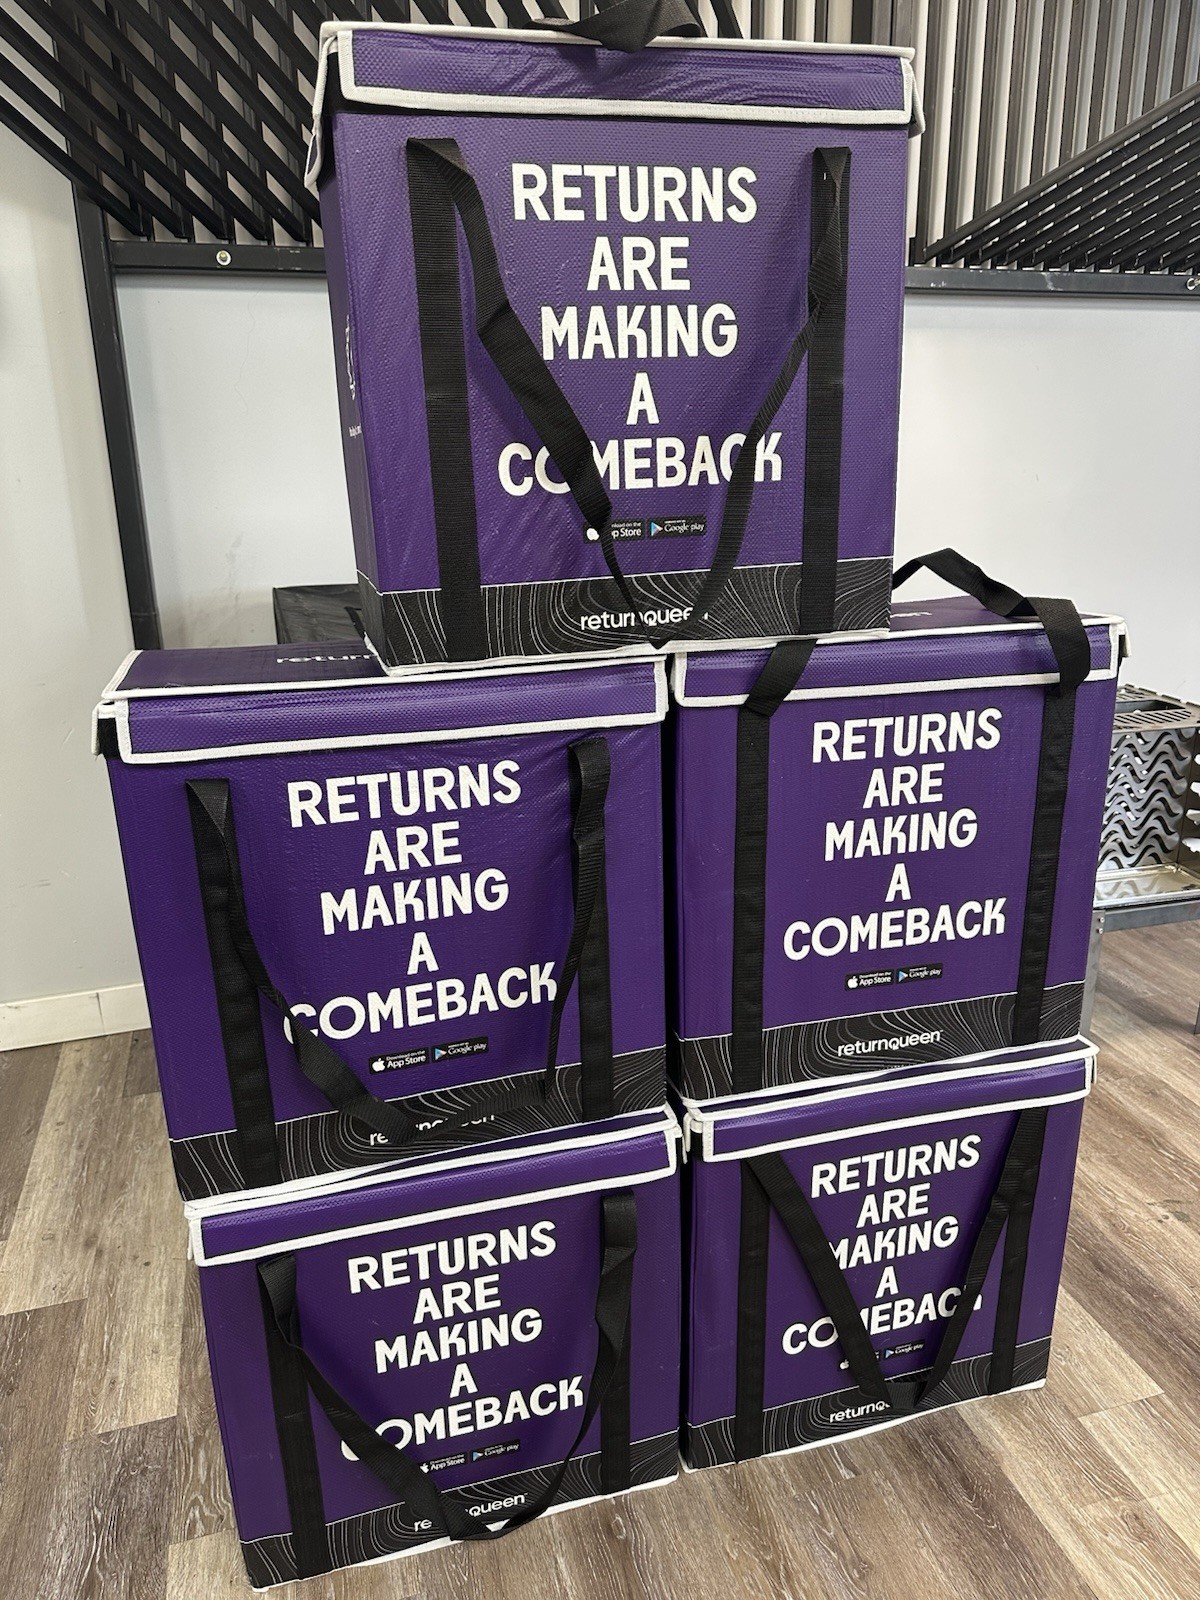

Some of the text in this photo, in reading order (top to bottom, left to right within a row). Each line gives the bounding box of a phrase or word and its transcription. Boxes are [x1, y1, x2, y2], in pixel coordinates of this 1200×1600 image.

[512, 163, 757, 223] RETURNS
[587, 237, 690, 293] ARE
[541, 304, 737, 361] MAKING
[627, 372, 659, 425] A
[620, 527, 642, 537] Store
[664, 522, 704, 533] Google play
[813, 708, 1002, 763] RETURNS
[288, 760, 520, 828] RETURNS
[863, 763, 944, 808] ARE
[364, 821, 462, 875] ARE
[825, 809, 977, 861] MAKING
[321, 869, 508, 936] MAKING
[885, 863, 911, 903] A
[408, 932, 438, 974] A
[784, 898, 1006, 961] COMEBACK
[859, 976, 892, 986] App Store
[909, 970, 928, 978] Google
[929, 968, 941, 976] play
[387, 1055, 427, 1069] App Store
[448, 1044, 472, 1055] Google
[473, 1042, 487, 1051] play
[812, 1134, 982, 1199] RETURNS
[856, 1182, 930, 1228] ARE
[348, 1221, 556, 1293] RETURNS
[875, 1265, 899, 1298] A
[413, 1274, 501, 1325] ARE
[782, 1285, 983, 1355] COEBAC
[375, 1309, 542, 1374] MAKING
[450, 1363, 477, 1398] A
[341, 1376, 584, 1461] OMEBACK
[430, 1462, 446, 1471] App
[446, 1457, 465, 1467] Store
